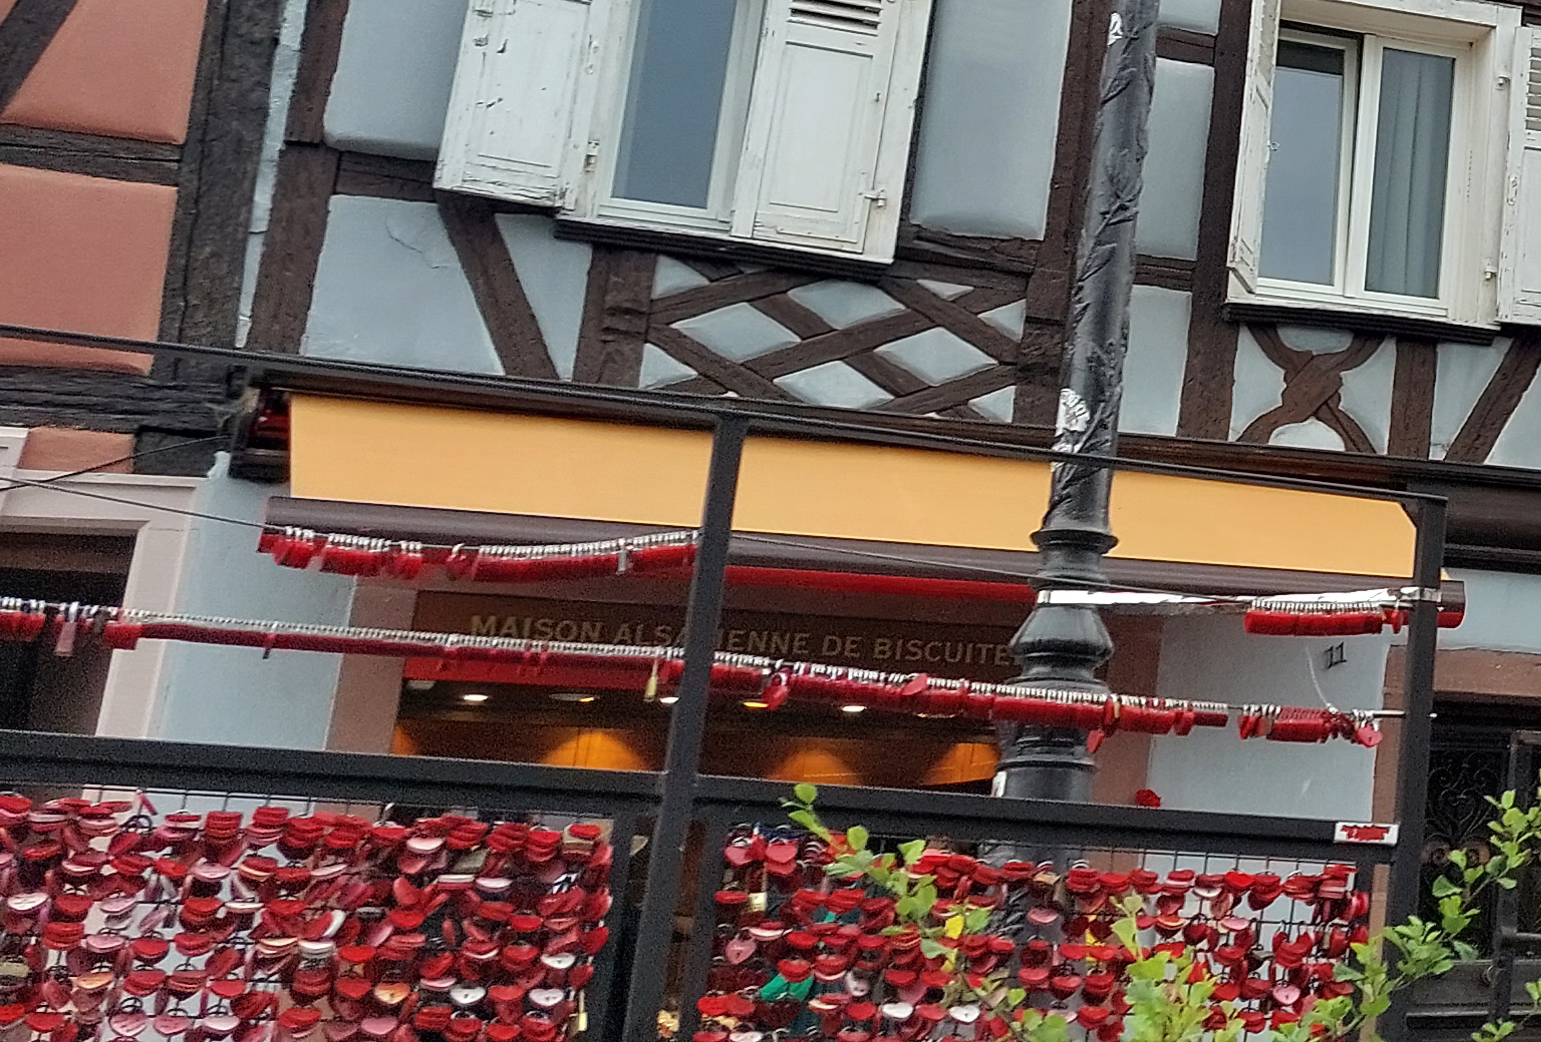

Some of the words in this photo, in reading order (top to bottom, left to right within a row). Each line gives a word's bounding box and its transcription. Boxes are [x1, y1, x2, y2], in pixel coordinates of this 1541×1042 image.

[471, 615, 601, 642] MAISON
[822, 635, 861, 657] DE
[873, 638, 1016, 666] BISCUITE
[1324, 641, 1347, 670] 11
